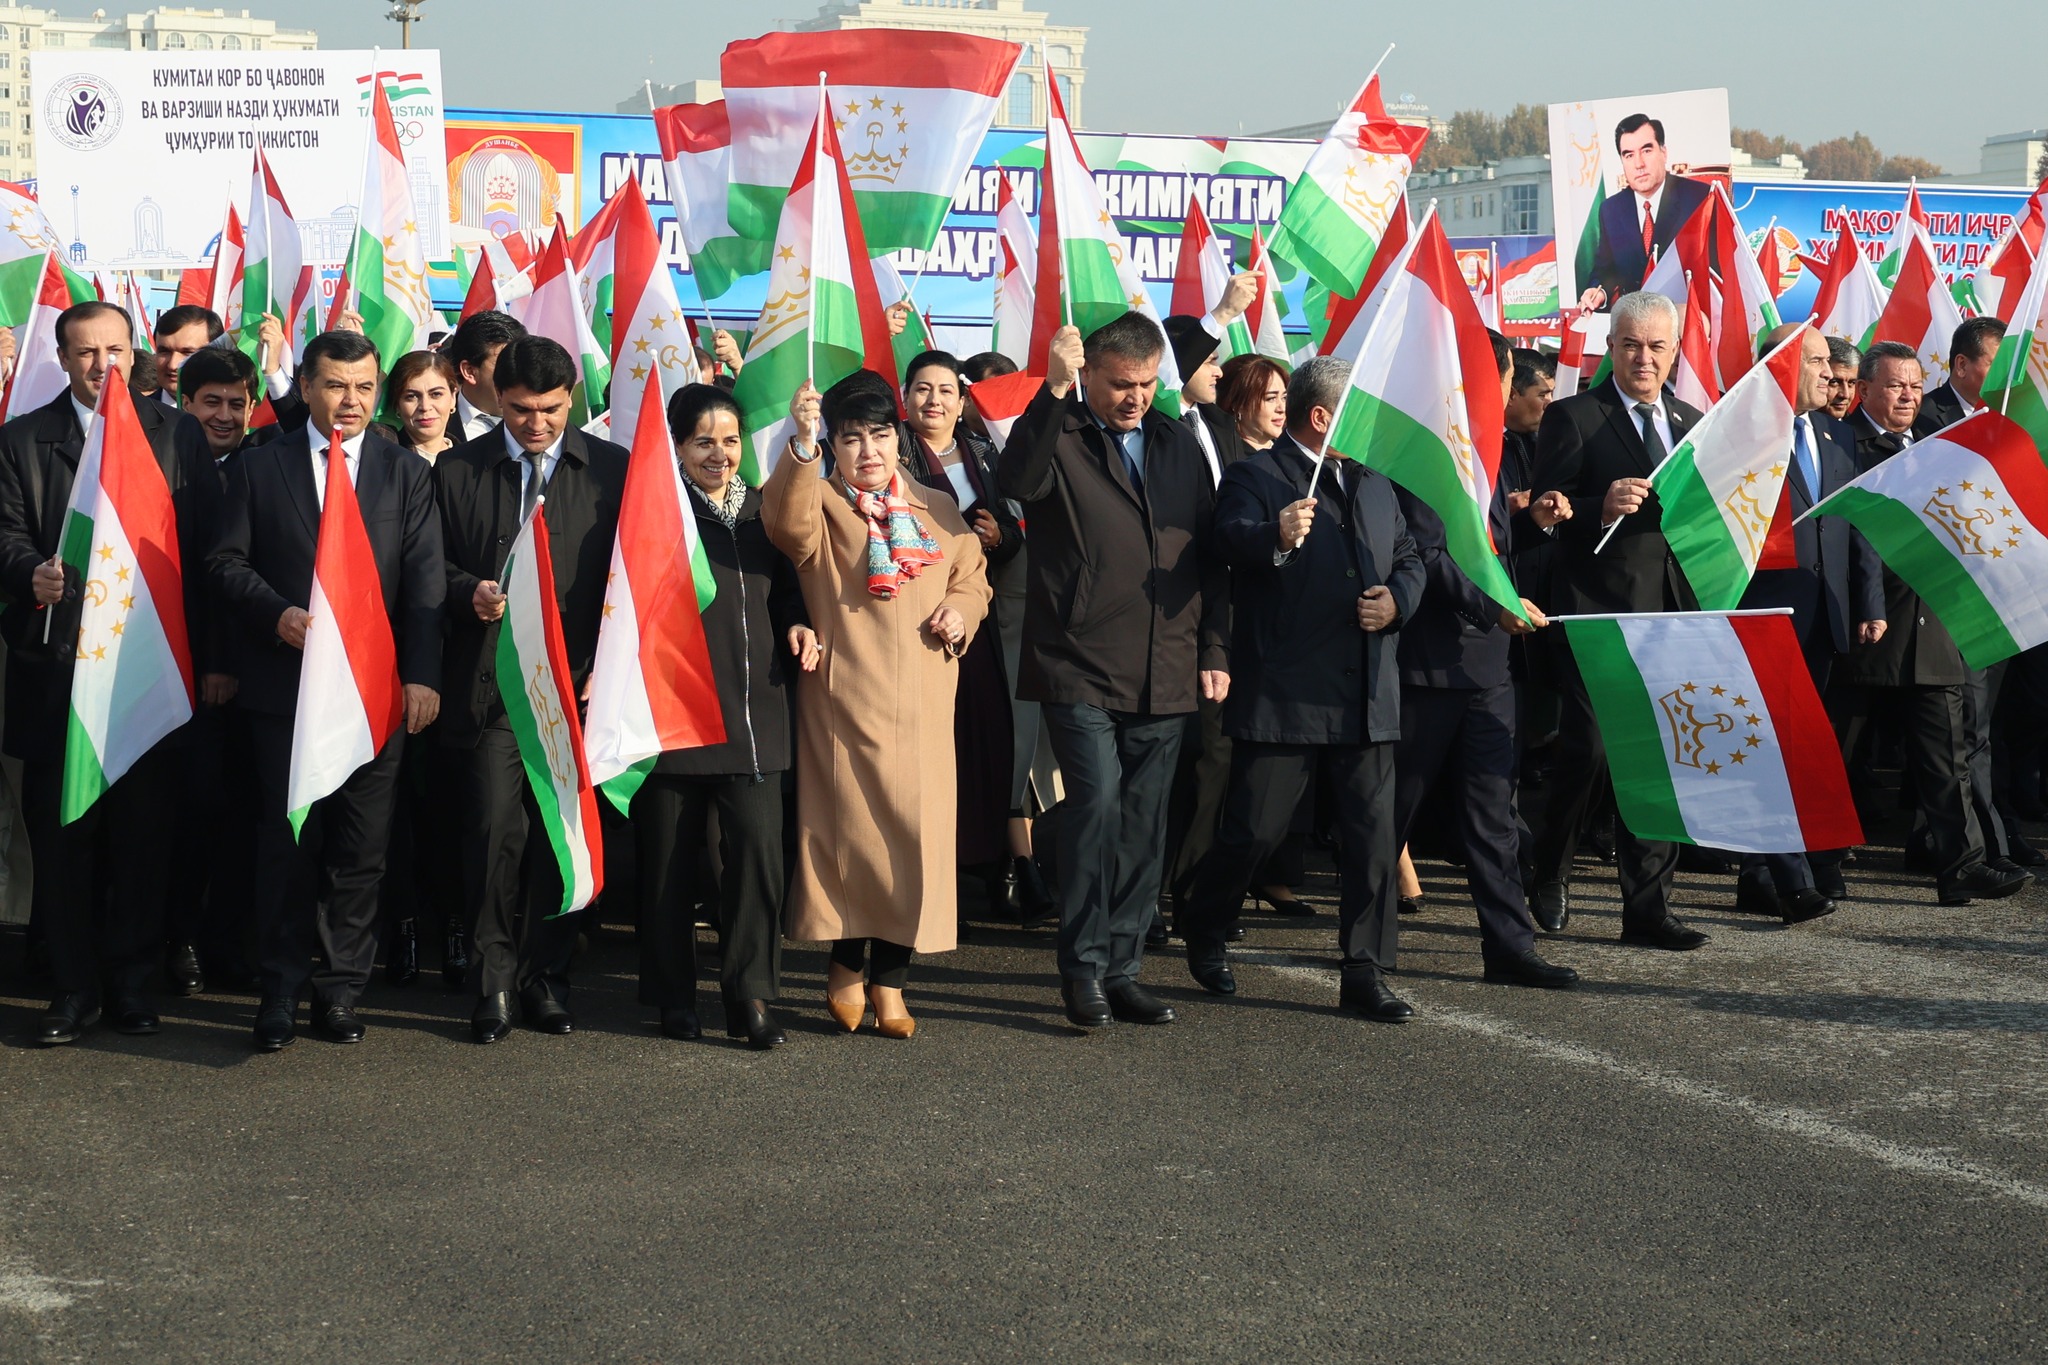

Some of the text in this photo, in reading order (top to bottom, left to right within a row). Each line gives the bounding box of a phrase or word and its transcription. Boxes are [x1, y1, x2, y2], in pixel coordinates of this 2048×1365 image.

[153, 69, 213, 87] КУМИТАИ
[217, 69, 241, 87] КОР
[246, 68, 262, 87] БО
[141, 100, 158, 119] ВА
[162, 100, 222, 119] ВАРЗИШИ
[227, 100, 269, 120] НАЗДИ
